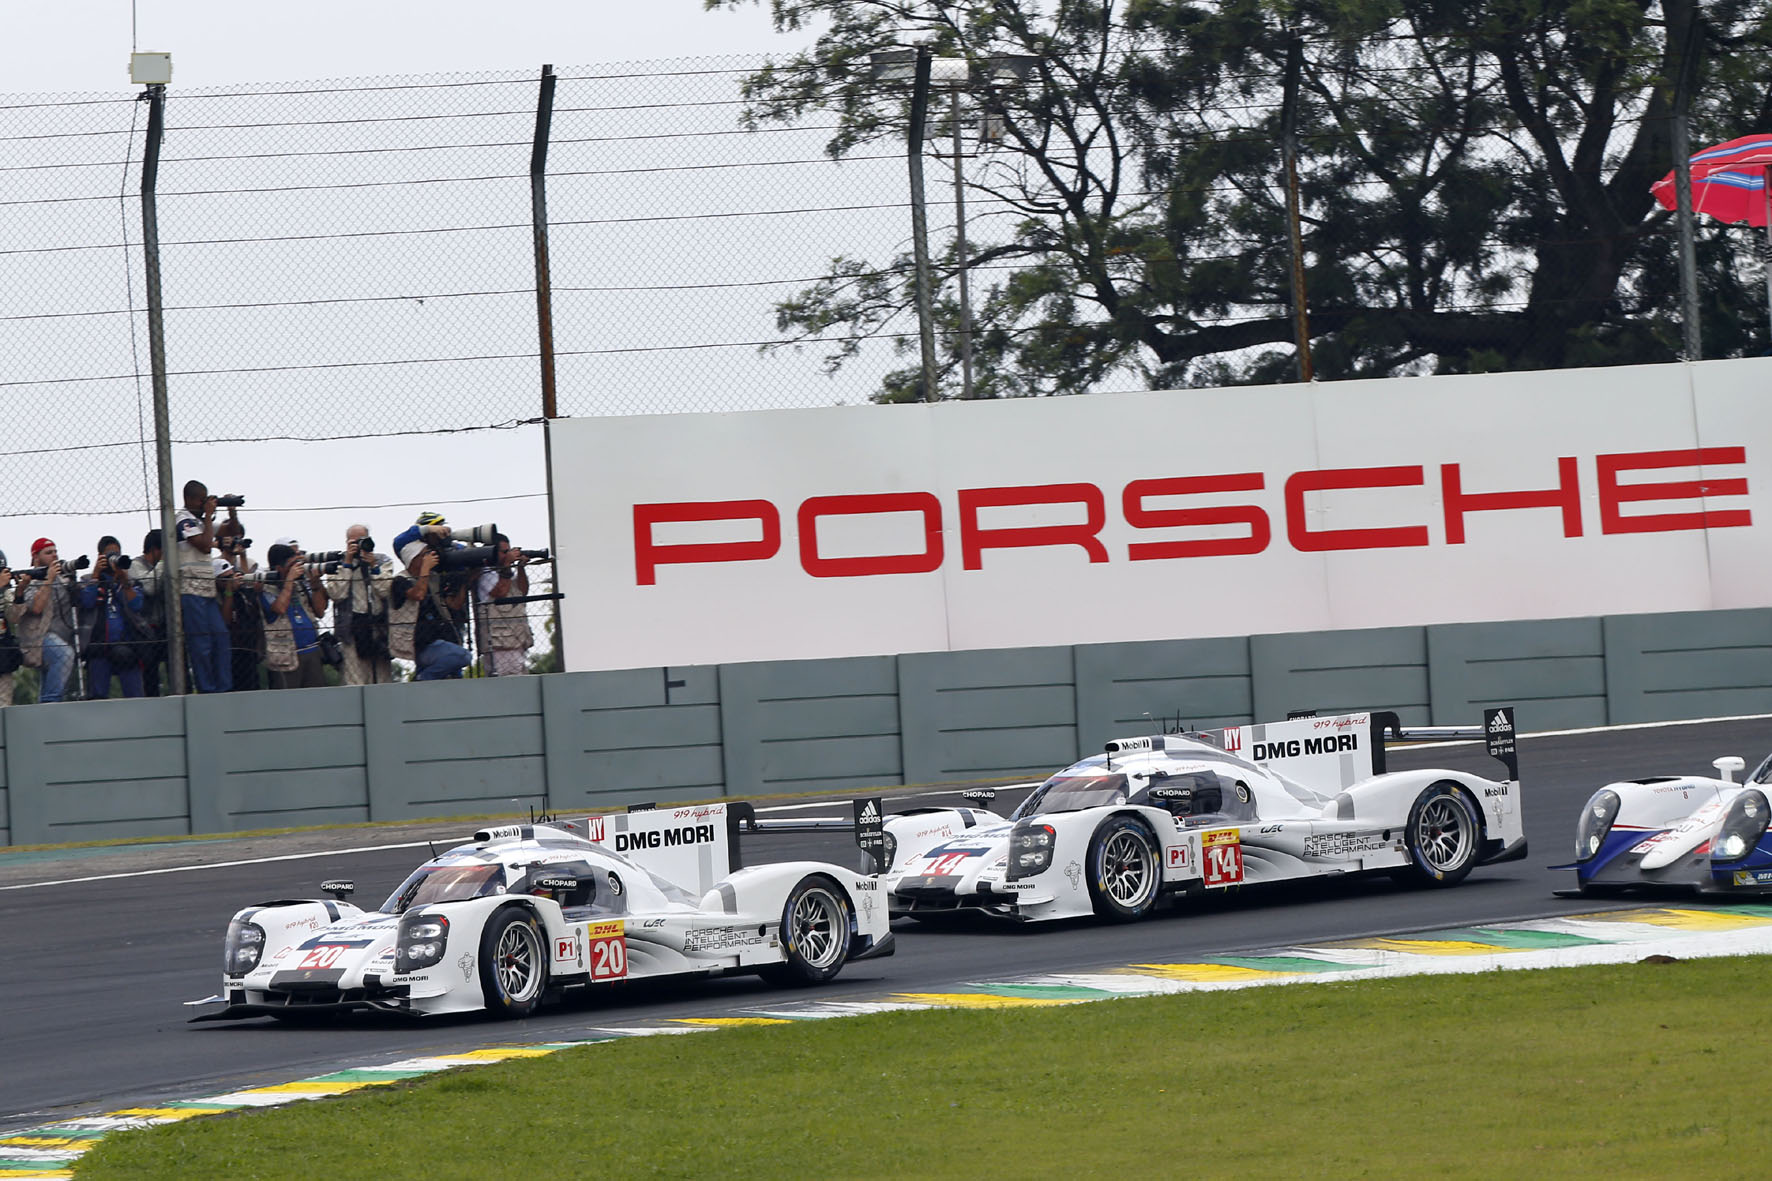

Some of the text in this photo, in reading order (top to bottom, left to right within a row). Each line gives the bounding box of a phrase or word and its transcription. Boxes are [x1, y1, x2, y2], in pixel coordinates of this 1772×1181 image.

[633, 446, 1752, 586] PORSCHE
[1313, 719, 1330, 729] 919
[1488, 724, 1512, 733] adidas
[1224, 728, 1240, 751] HY
[1252, 734, 1358, 761] DMG MORI
[1156, 789, 1191, 797] CHOPARD
[1683, 791, 1689, 800] 8
[673, 809, 690, 820] 919
[859, 816, 881, 824] adidas
[588, 818, 604, 841] HY
[1260, 824, 1284, 834] WEC
[615, 824, 715, 852] DMG MORI
[1304, 832, 1357, 844] PORSCHE
[1304, 837, 1371, 851] INTELLIGENT
[1302, 842, 1386, 857] PERFORMANCE
[1171, 849, 1186, 865] P1
[1207, 846, 1240, 882] 14
[927, 854, 959, 875] 14
[542, 879, 577, 887] CHOPARD
[594, 924, 619, 935] DHL
[643, 919, 667, 928] WEC
[685, 926, 734, 938] PORSCHE
[685, 931, 748, 945] INTELLIGENT
[559, 941, 573, 957] P1
[683, 937, 762, 952] PERFORMANCE
[300, 946, 344, 968] 20
[594, 939, 624, 976] 20
